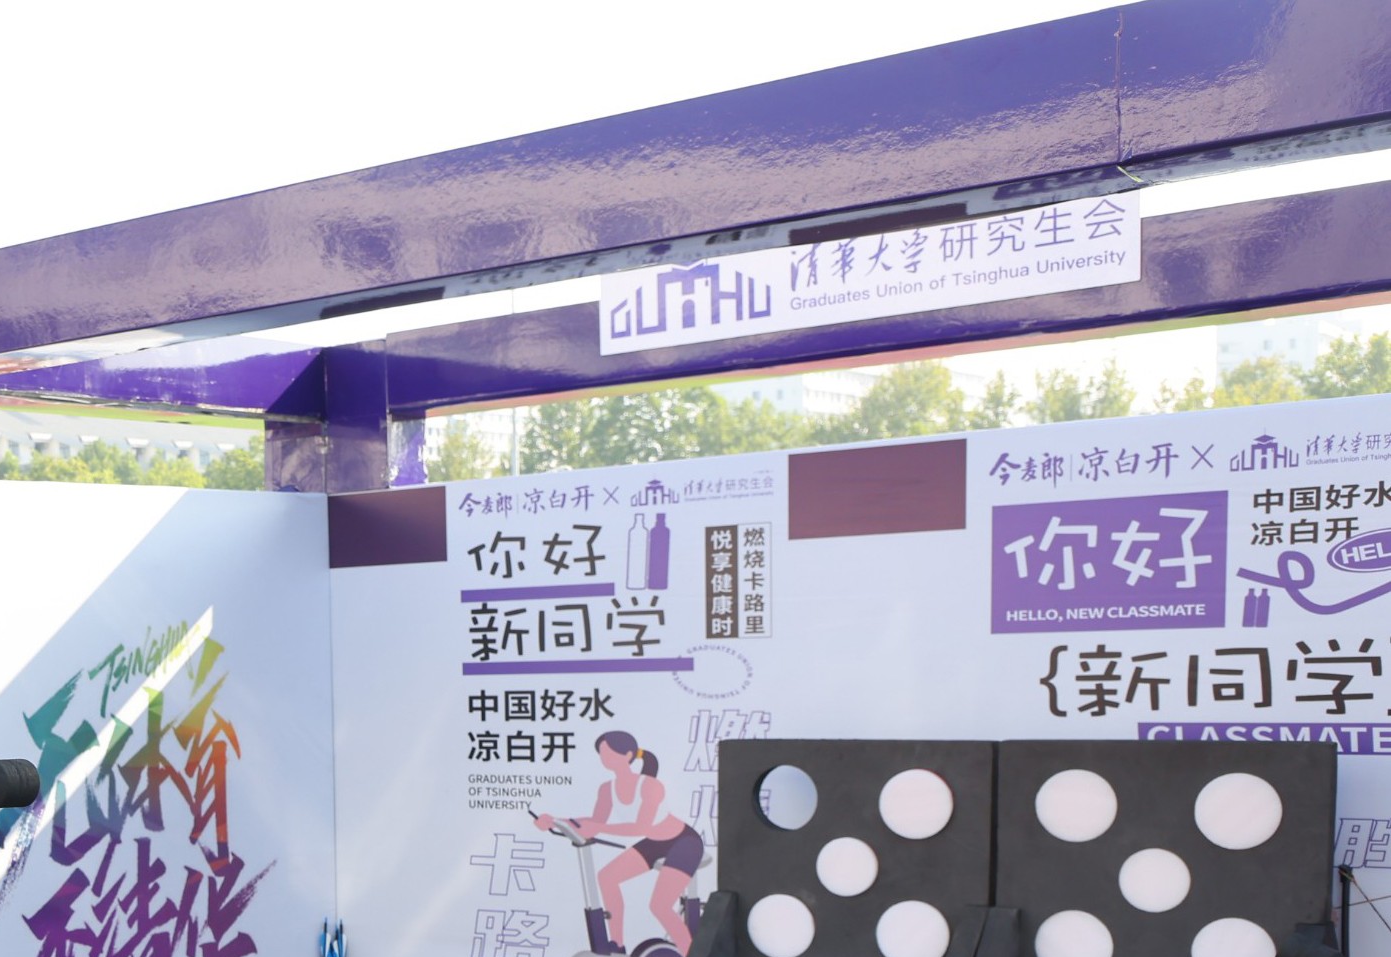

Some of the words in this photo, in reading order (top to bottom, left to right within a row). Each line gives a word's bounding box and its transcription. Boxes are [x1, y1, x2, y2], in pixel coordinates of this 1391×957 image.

[790, 288, 870, 310] Graduates
[876, 281, 923, 298] Union
[929, 275, 947, 290] of
[952, 265, 1029, 286] Tsinghua
[1036, 250, 1126, 274] University
[989, 452, 1064, 489] 今麦郎
[1077, 442, 1180, 482] 凉白开
[1306, 457, 1339, 466] Graduates
[1340, 455, 1360, 463] Union
[458, 492, 513, 519] 今麦郎
[522, 485, 595, 514] 凉白开
[1253, 480, 1391, 514] 中国好水
[1250, 517, 1359, 546] 凉白开
[467, 523, 606, 579] 你好
[1003, 507, 1213, 591] 你好
[711, 529, 734, 636] 悦享健康时
[743, 527, 766, 634] 燃烧卡路里
[469, 596, 666, 661] 新同学
[1006, 609, 1064, 623] HELLO,
[1066, 607, 1105, 620] NEW
[1107, 604, 1206, 618] CLASSMATE
[467, 688, 615, 723] 中国好水
[467, 731, 577, 764] 凉白开
[467, 774, 532, 785] GRADUATES
[535, 775, 573, 785] UNION
[468, 787, 483, 796] OF
[485, 787, 542, 798] TSINGHUA
[468, 799, 532, 810] UNIVERSITY
